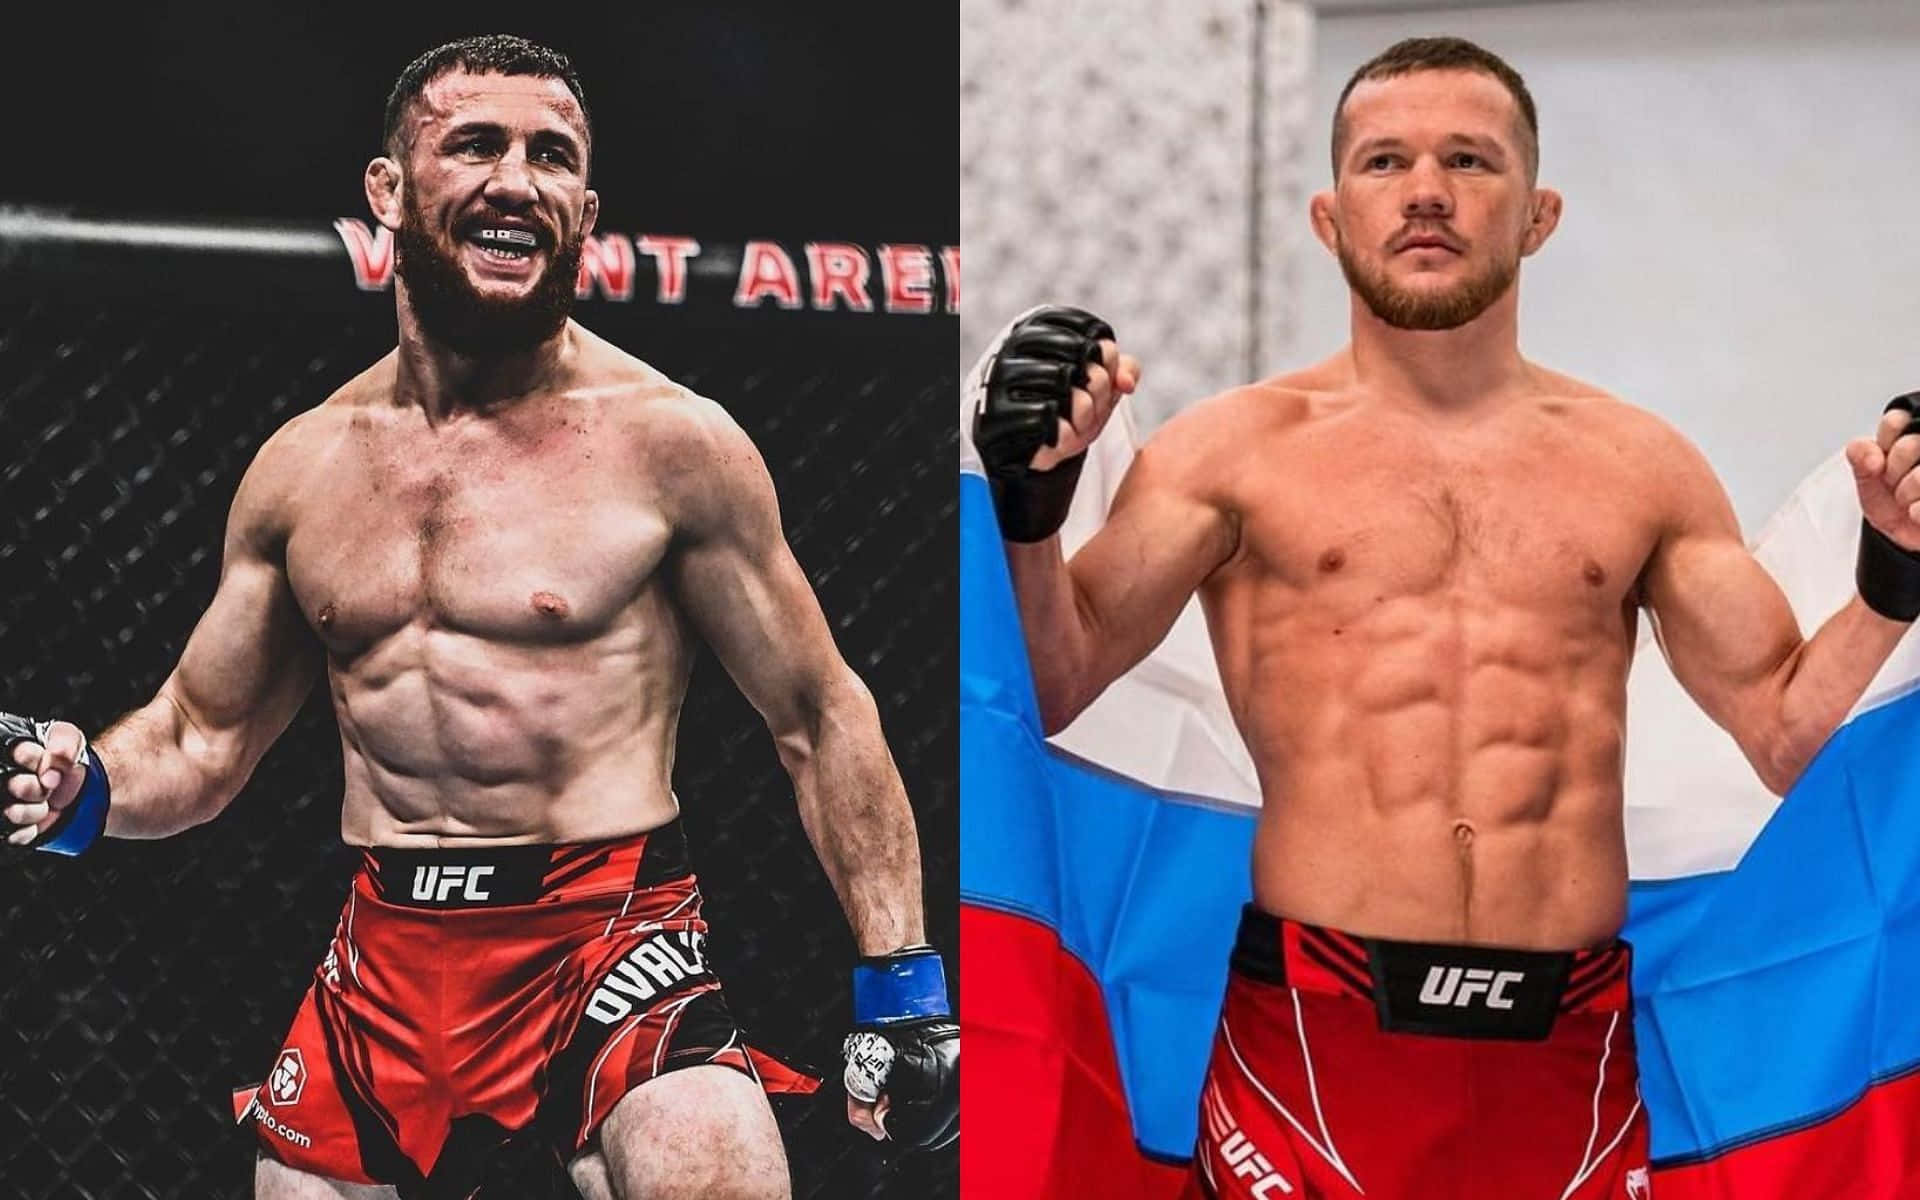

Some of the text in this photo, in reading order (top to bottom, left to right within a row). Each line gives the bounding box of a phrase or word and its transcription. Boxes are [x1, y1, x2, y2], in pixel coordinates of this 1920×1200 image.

[412, 866, 494, 901] UFC
[1419, 966, 1524, 1009] UFC
[1220, 1131, 1293, 1200] UFC
